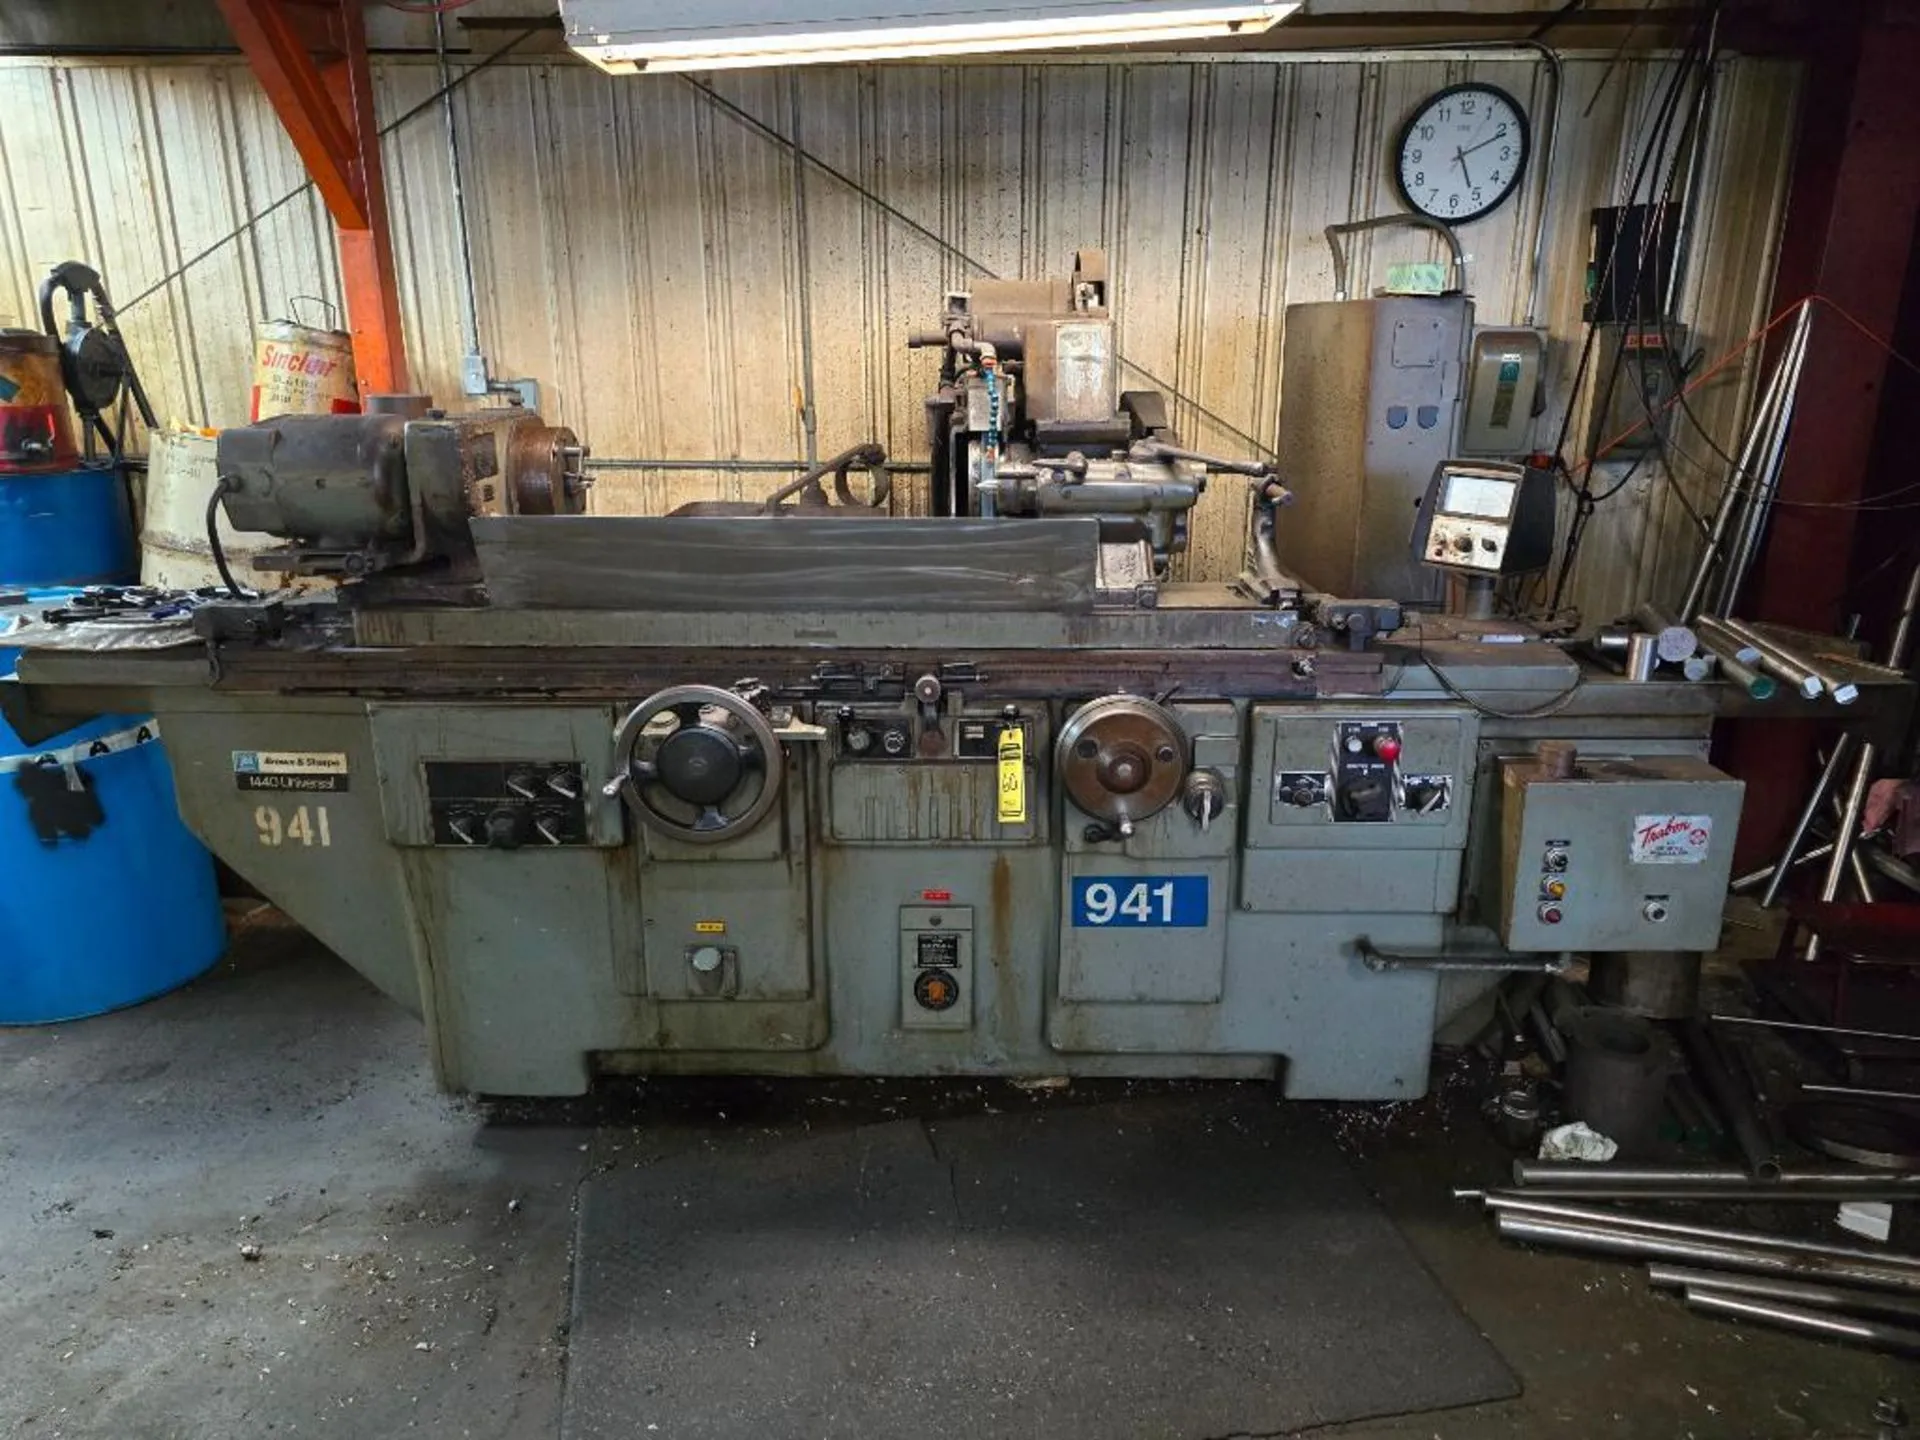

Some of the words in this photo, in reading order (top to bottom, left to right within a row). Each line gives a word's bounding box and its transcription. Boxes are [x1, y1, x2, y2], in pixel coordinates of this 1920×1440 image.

[1438, 108, 1451, 122] 11
[1460, 100, 1476, 115] 12
[1420, 125, 1434, 141] 10
[1496, 123, 1507, 138] 2
[1412, 149, 1422, 163] 9
[1499, 145, 1511, 161] 3
[1415, 171, 1425, 186] 8
[1490, 170, 1500, 185] 4
[1429, 188, 1439, 202] 7
[1449, 194, 1458, 208] 6
[1471, 187, 1482, 201] 5
[254, 805, 331, 847] 941
[1085, 881, 1174, 924] 941
